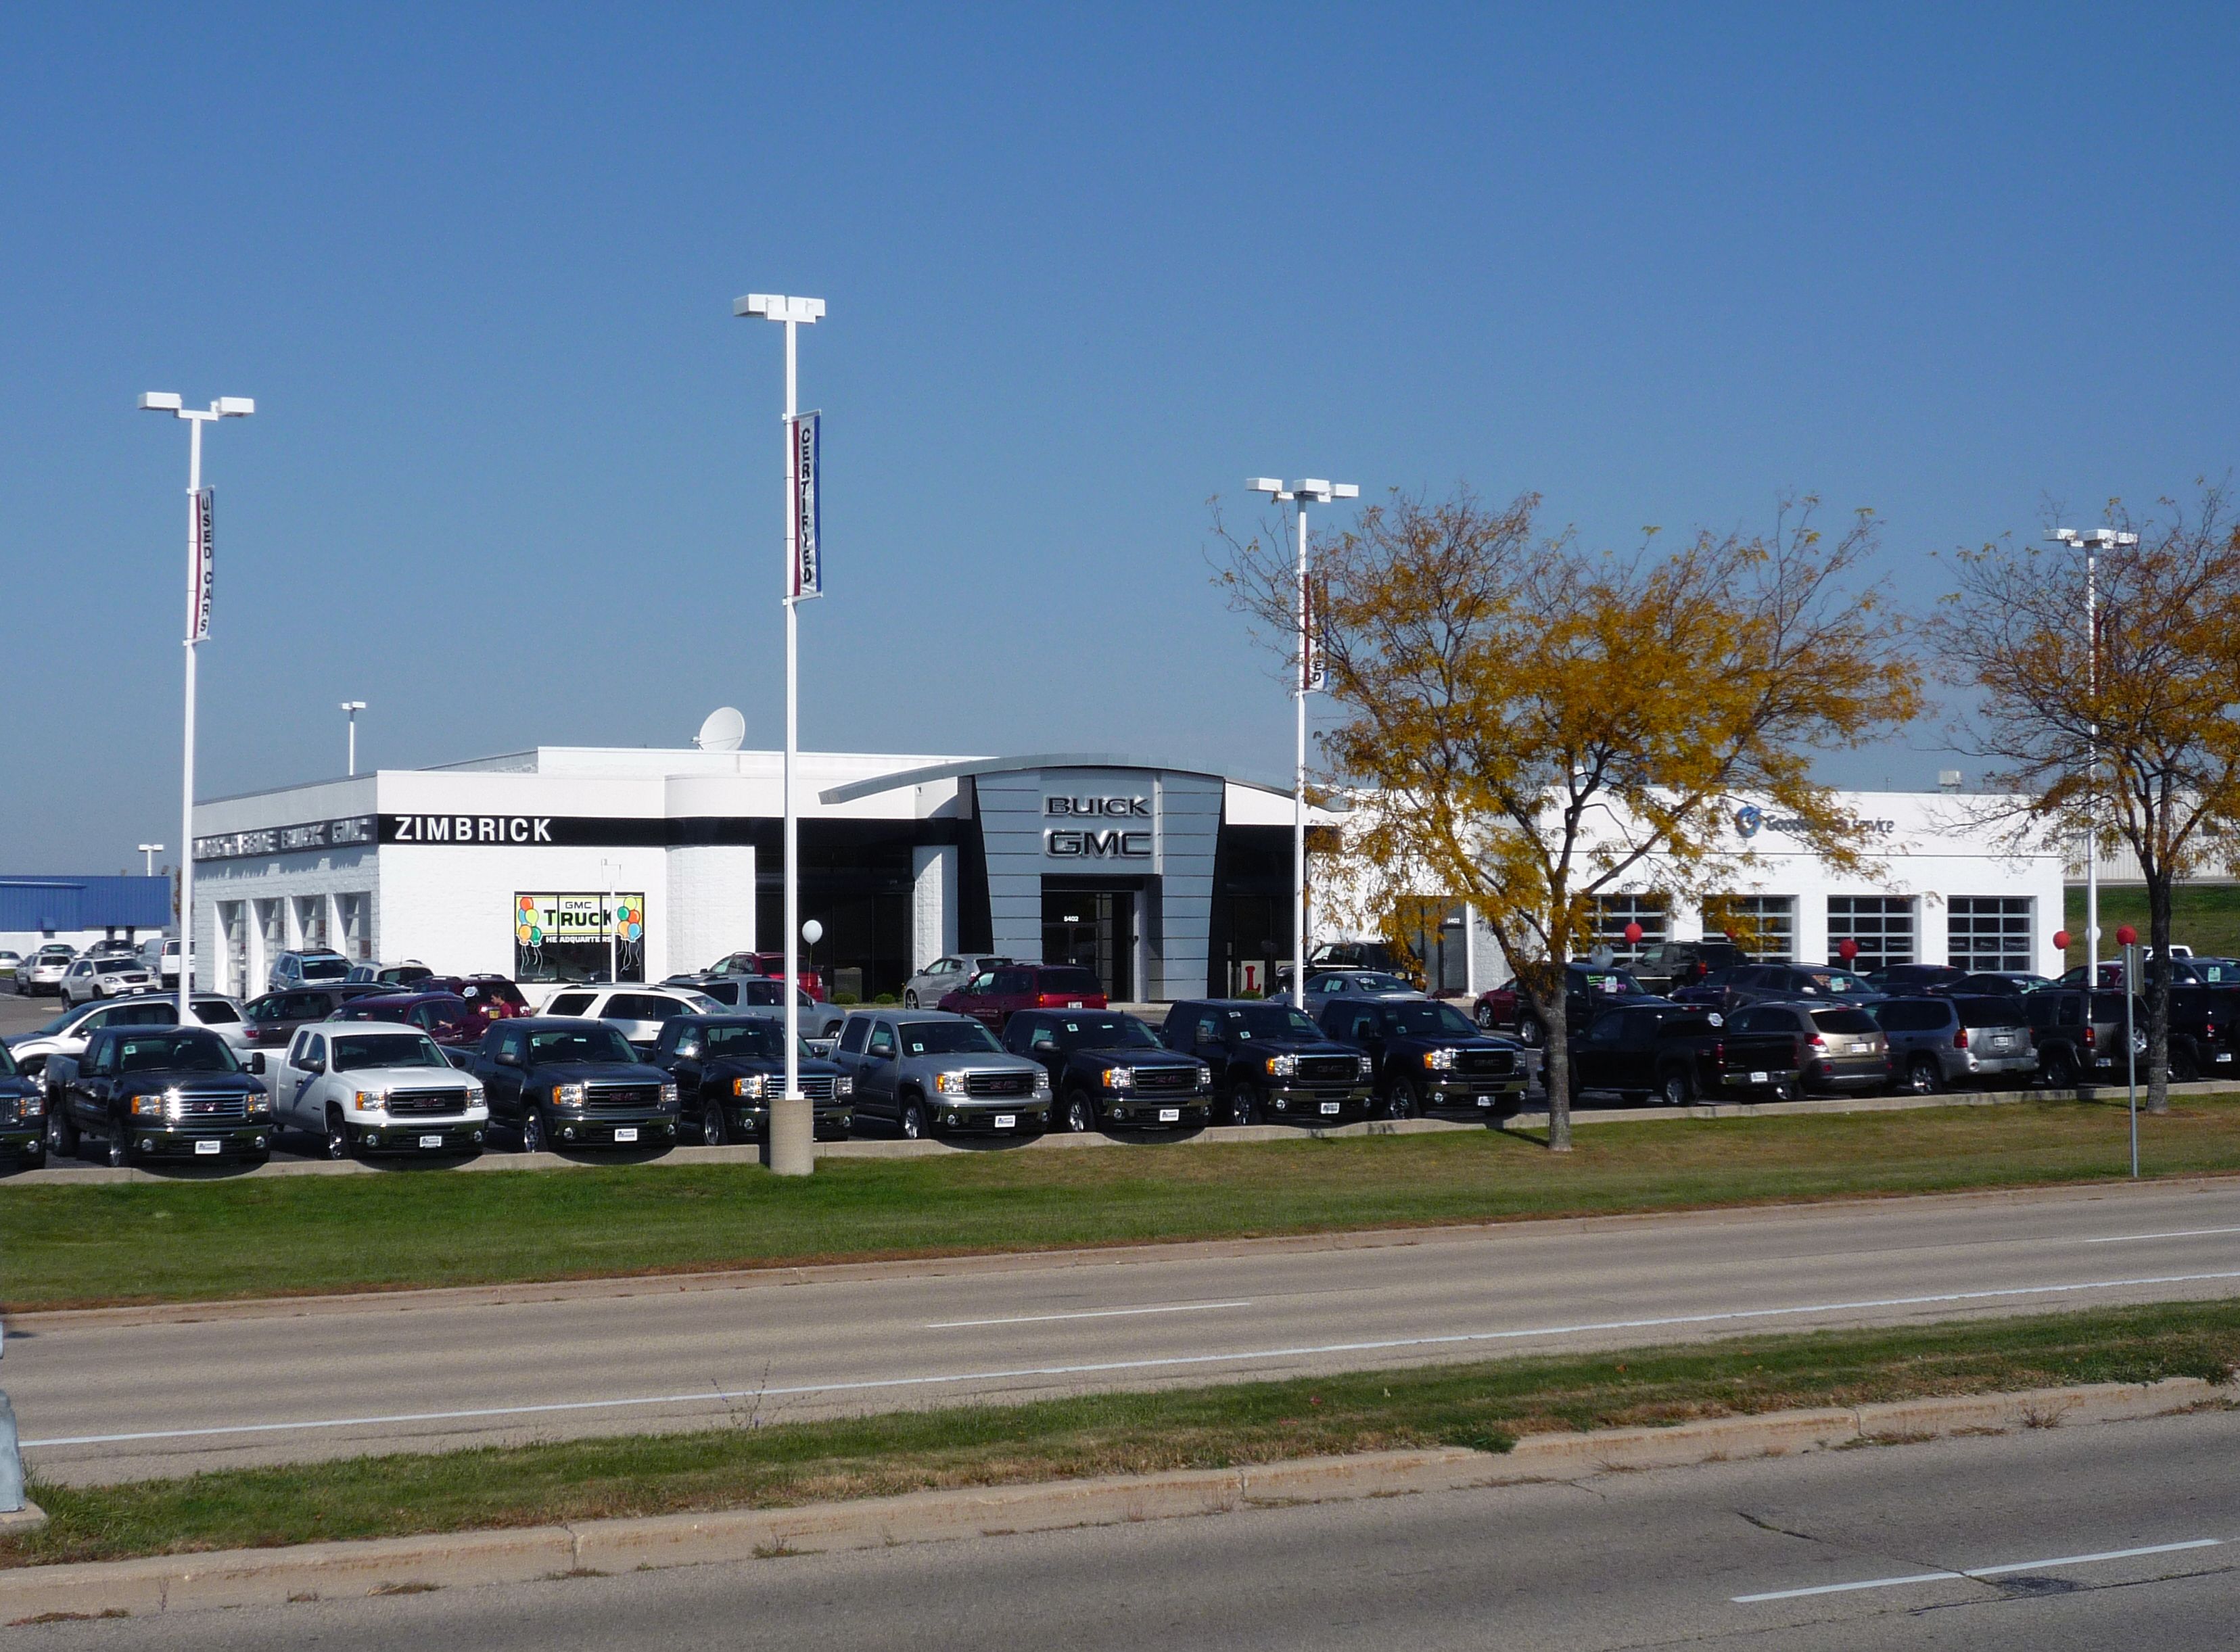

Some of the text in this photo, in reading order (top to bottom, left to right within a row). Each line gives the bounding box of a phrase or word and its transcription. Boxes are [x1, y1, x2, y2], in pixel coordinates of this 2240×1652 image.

[800, 427, 812, 584] CERTIFIED
[199, 497, 213, 632] USED CARS
[1047, 797, 1151, 816] BUICK
[394, 816, 553, 843] ZIMBRICK
[1048, 830, 1152, 856] GMC
[543, 909, 612, 926] TRUCK
[565, 901, 592, 910] GMC
